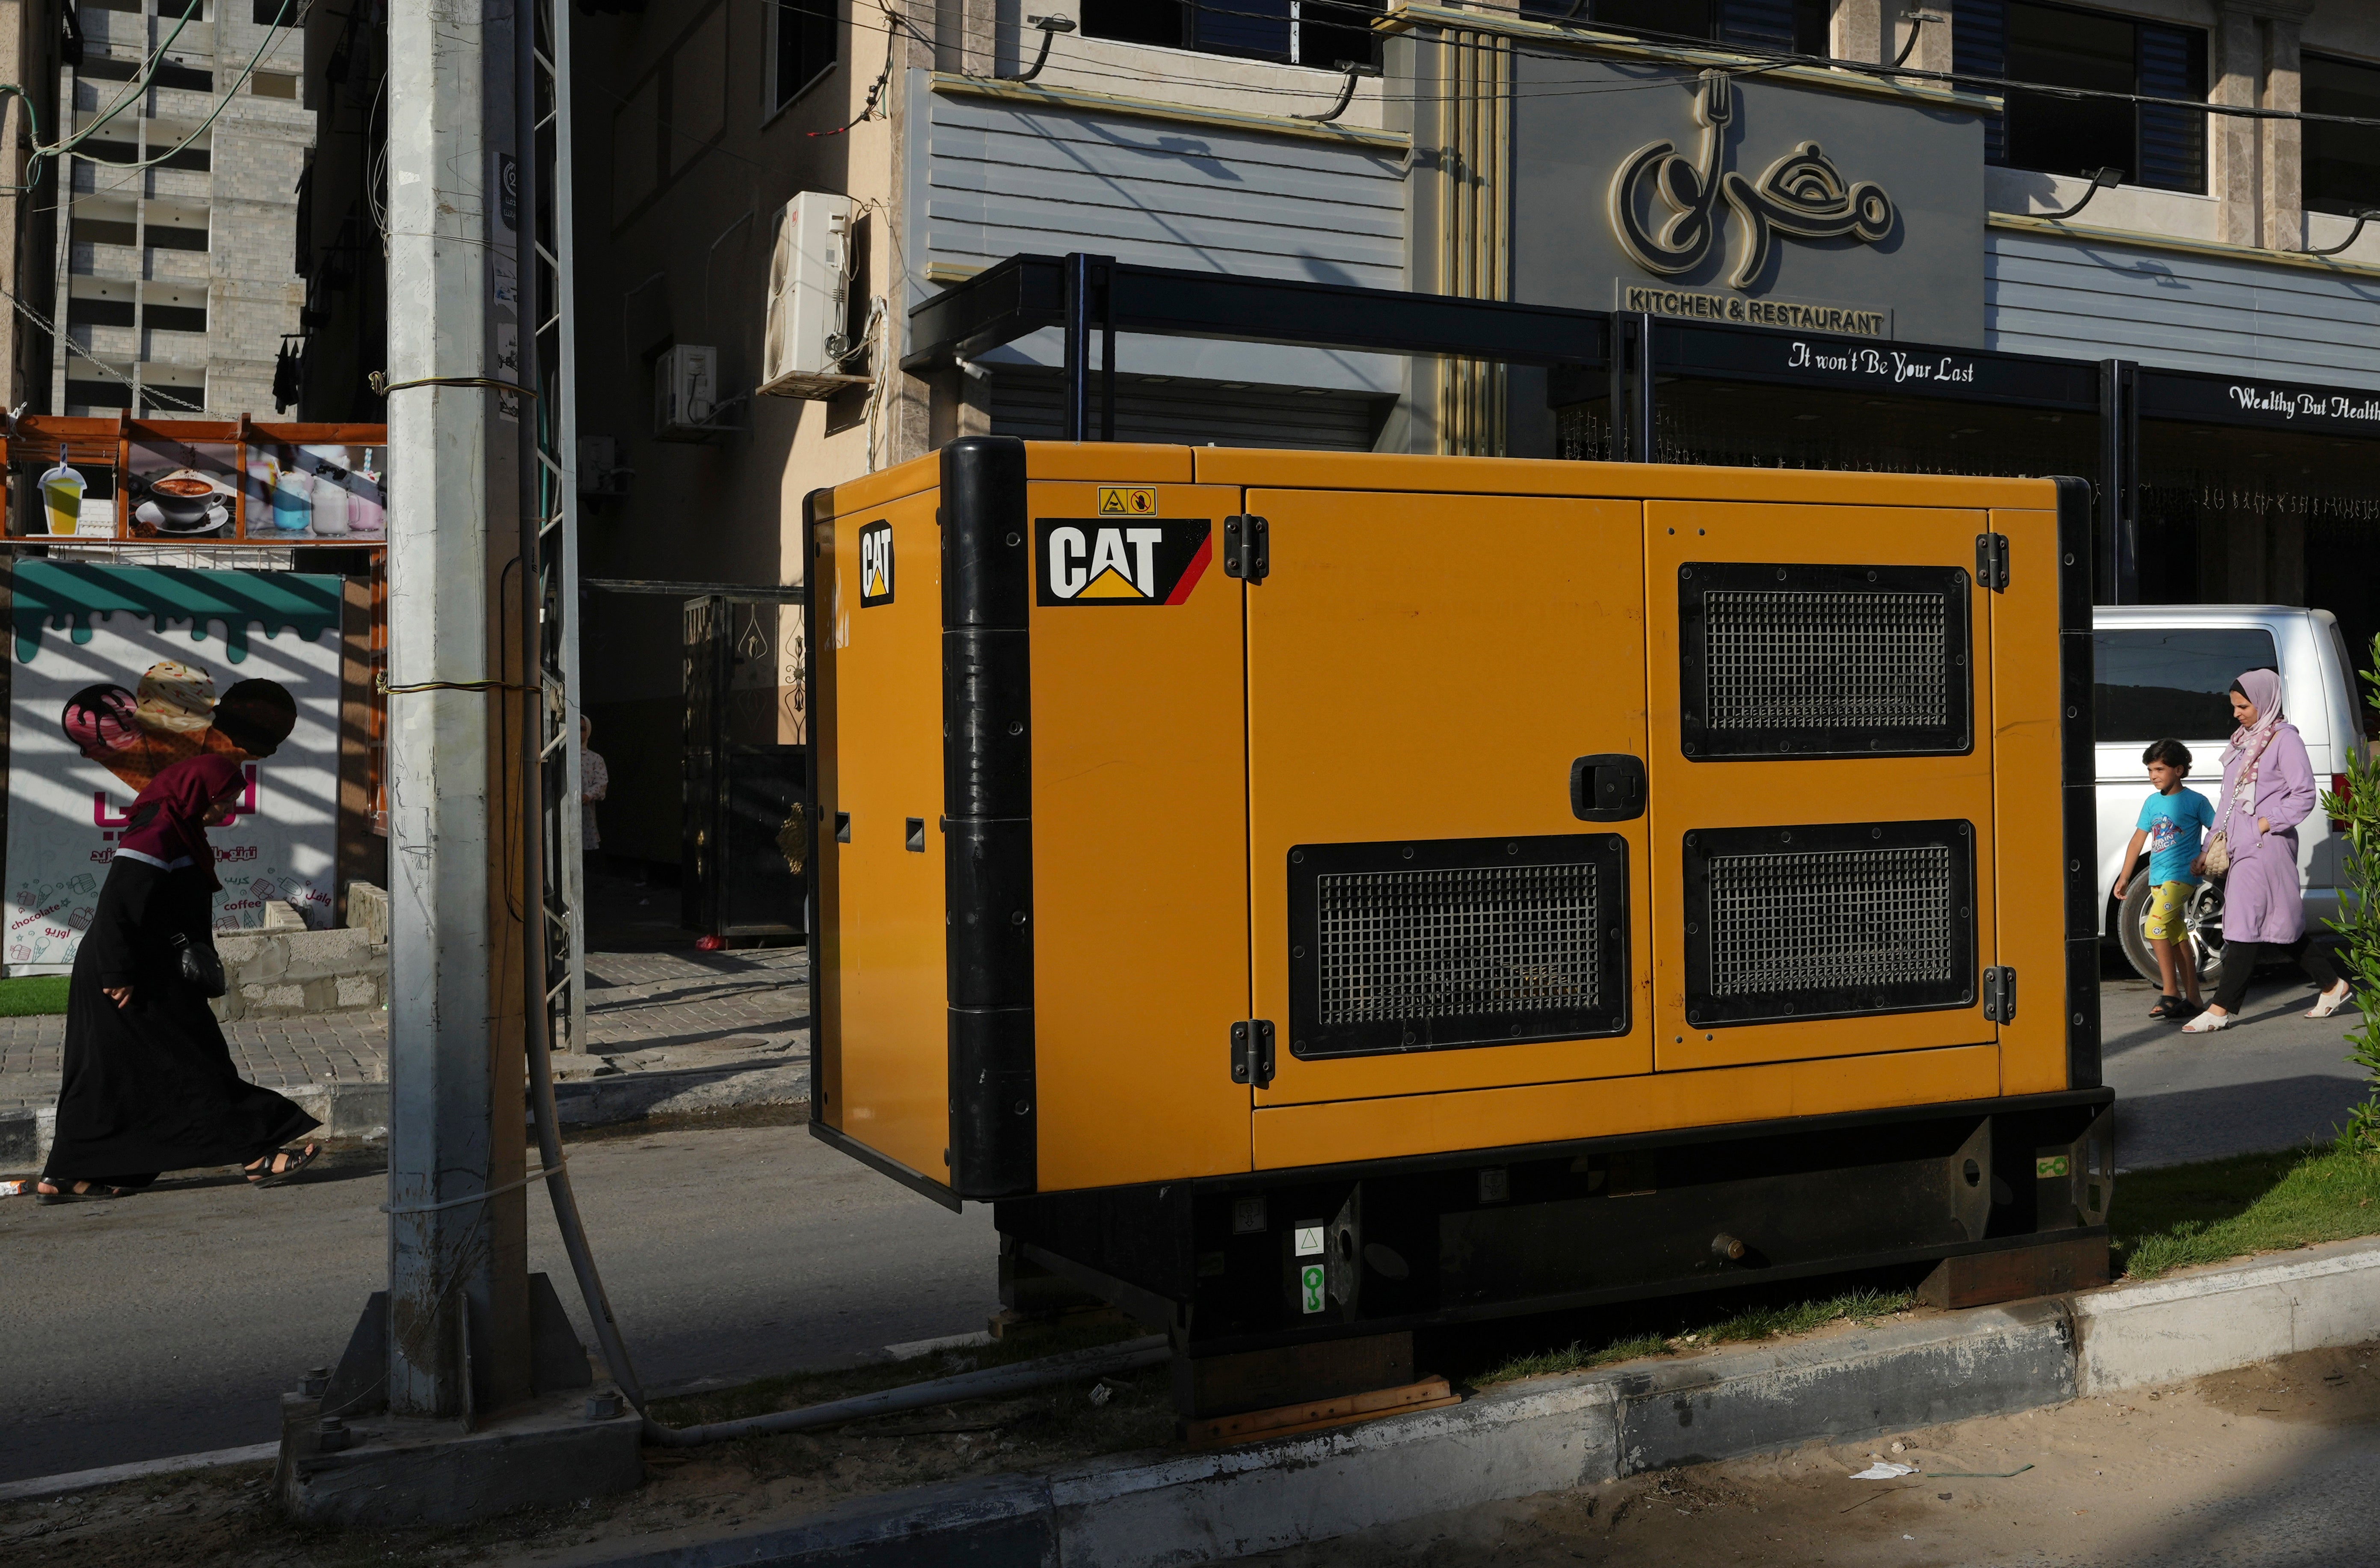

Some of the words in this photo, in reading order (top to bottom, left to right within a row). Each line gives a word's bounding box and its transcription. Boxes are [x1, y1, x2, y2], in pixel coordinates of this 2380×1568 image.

[1626, 286, 1722, 319] KITCHEN
[1725, 297, 1745, 322] &
[1745, 299, 1884, 336] RESTAURANT
[1788, 342, 1811, 368] It
[1815, 347, 1857, 371] won't
[1860, 349, 1888, 374] Be
[1890, 352, 1931, 383] Your
[1934, 357, 1974, 383] Last
[2229, 386, 2295, 419] Wealthy
[2297, 394, 2327, 415] But
[862, 528, 891, 598] CAT
[1049, 526, 1162, 599] CAT
[228, 846, 257, 862] تمتع
[2152, 840, 2177, 852] ERICA
[225, 876, 249, 885] كريب
[224, 900, 261, 911] coffee
[306, 889, 332, 907] وافل
[12, 904, 60, 930] chocolate
[45, 927, 71, 939] اوريو
